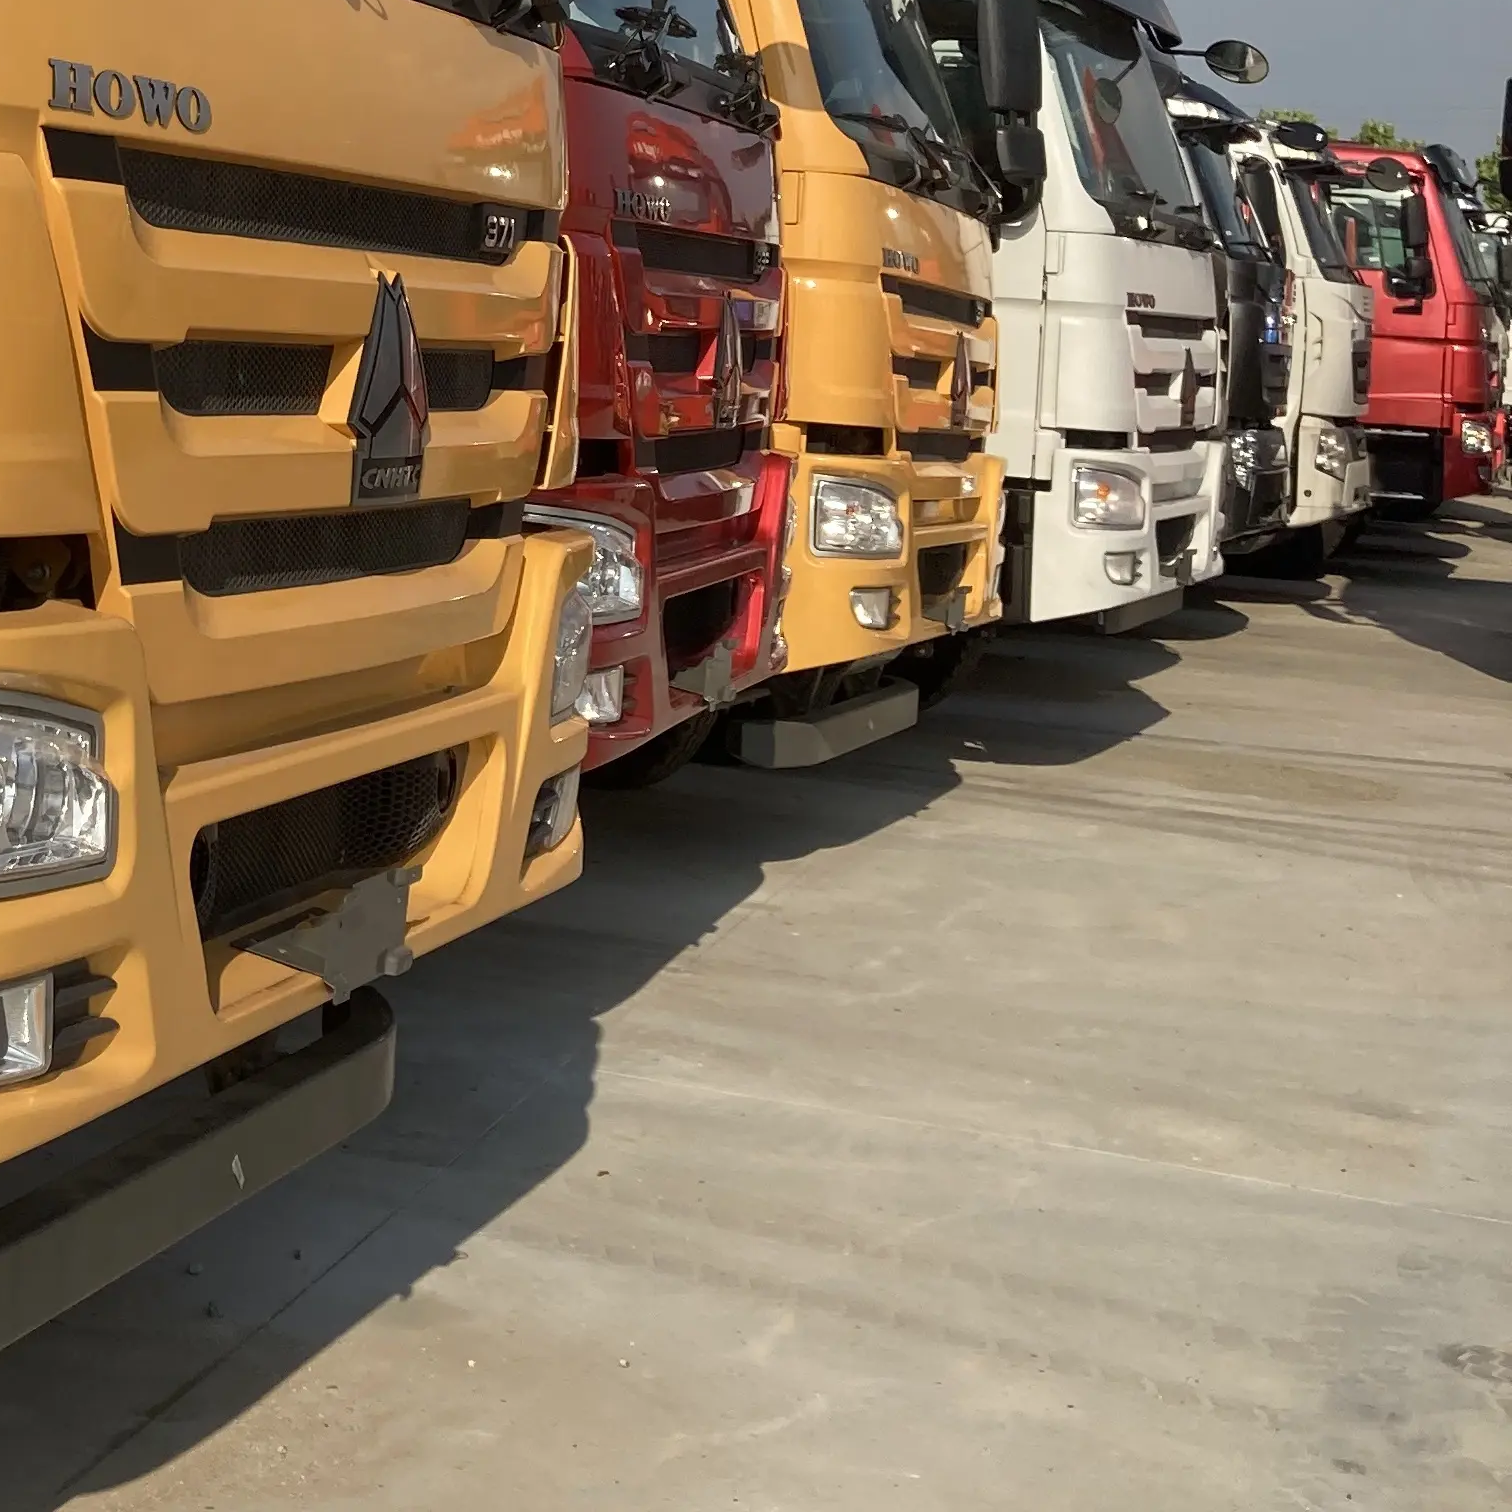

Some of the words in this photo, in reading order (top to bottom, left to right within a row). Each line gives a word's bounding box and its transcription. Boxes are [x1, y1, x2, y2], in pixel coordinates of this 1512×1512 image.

[48, 57, 213, 136] HOWO
[614, 188, 673, 223] HOWO
[484, 215, 515, 249] 371
